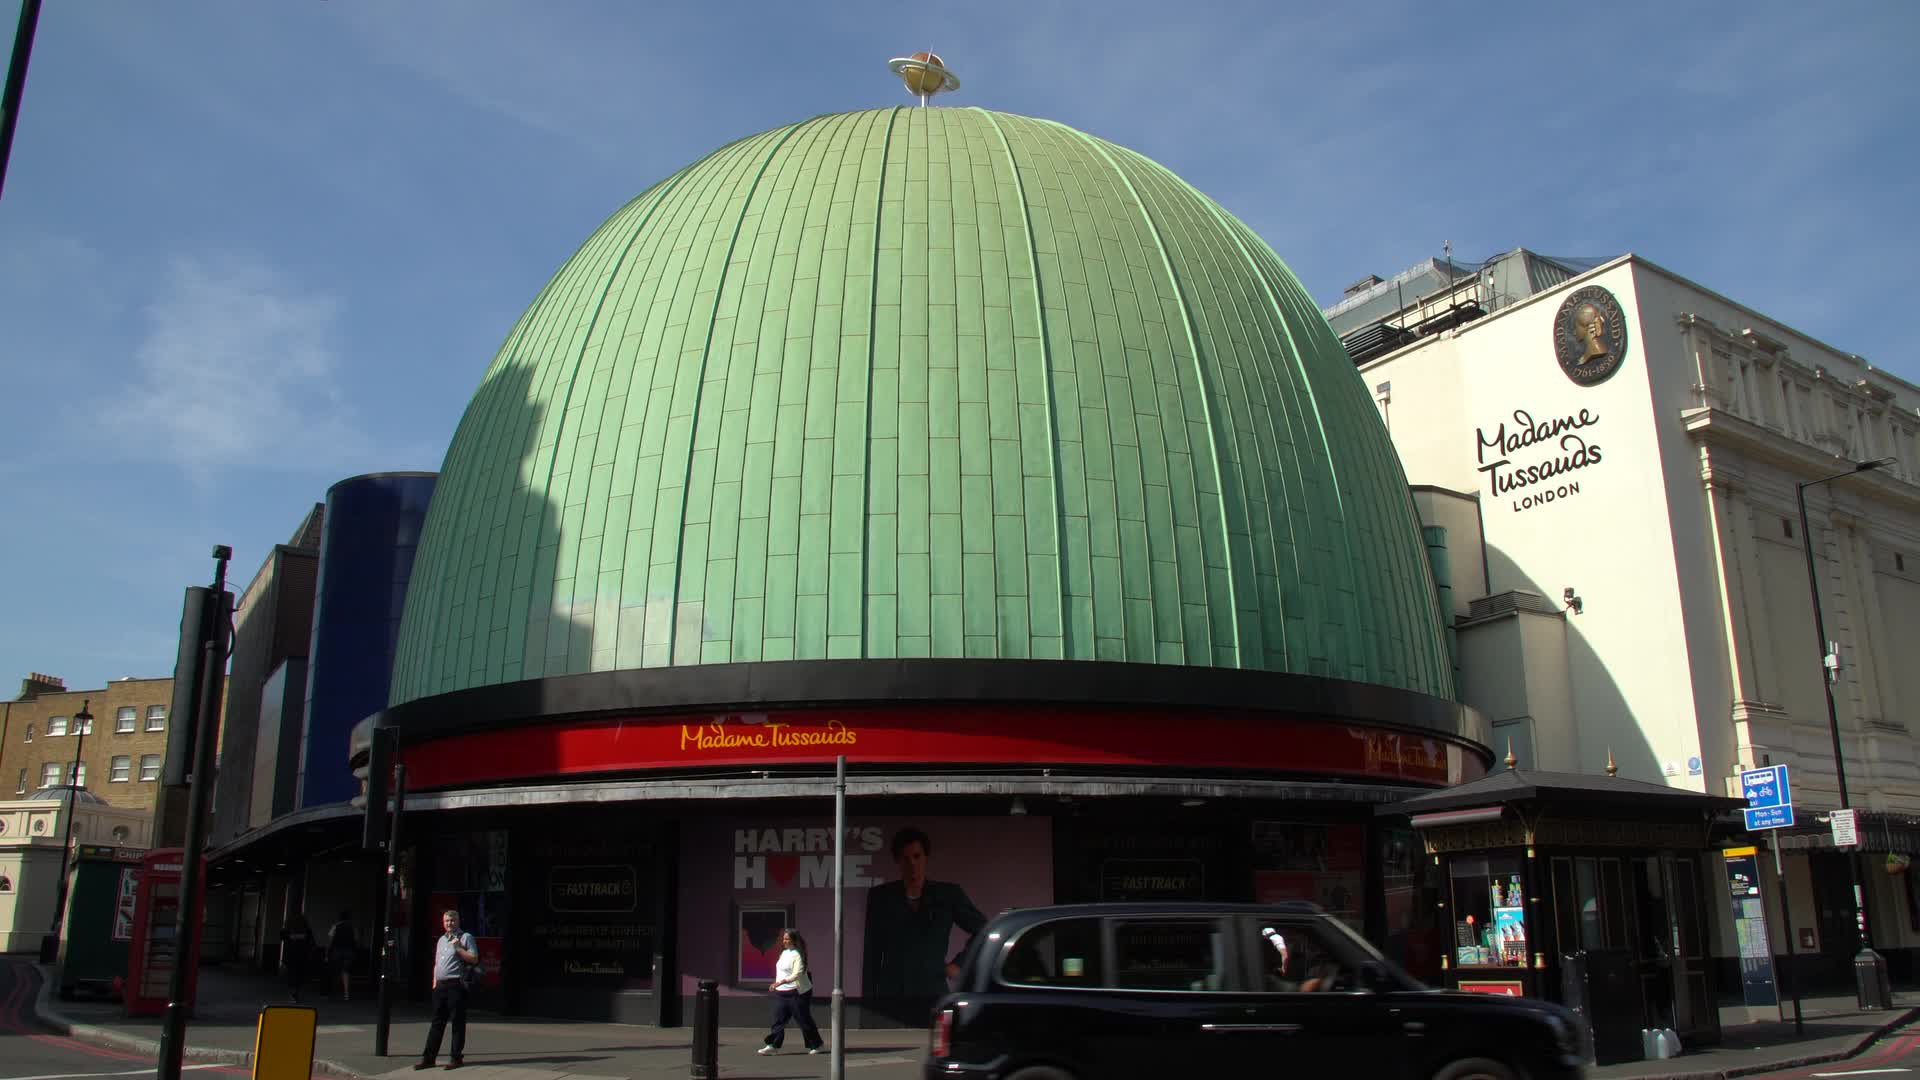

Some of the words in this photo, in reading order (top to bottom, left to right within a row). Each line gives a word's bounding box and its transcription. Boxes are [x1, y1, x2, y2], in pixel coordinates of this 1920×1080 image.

[1556, 292, 1581, 359] MADAME
[1583, 287, 1622, 339] TUSSAUD
[1476, 408, 1600, 464] Madame
[1477, 434, 1602, 497] Tussauds
[1513, 481, 1580, 512] LONDON
[681, 720, 769, 751] Madame
[764, 719, 857, 748] Tussauds
[735, 826, 883, 853] HARRY'S
